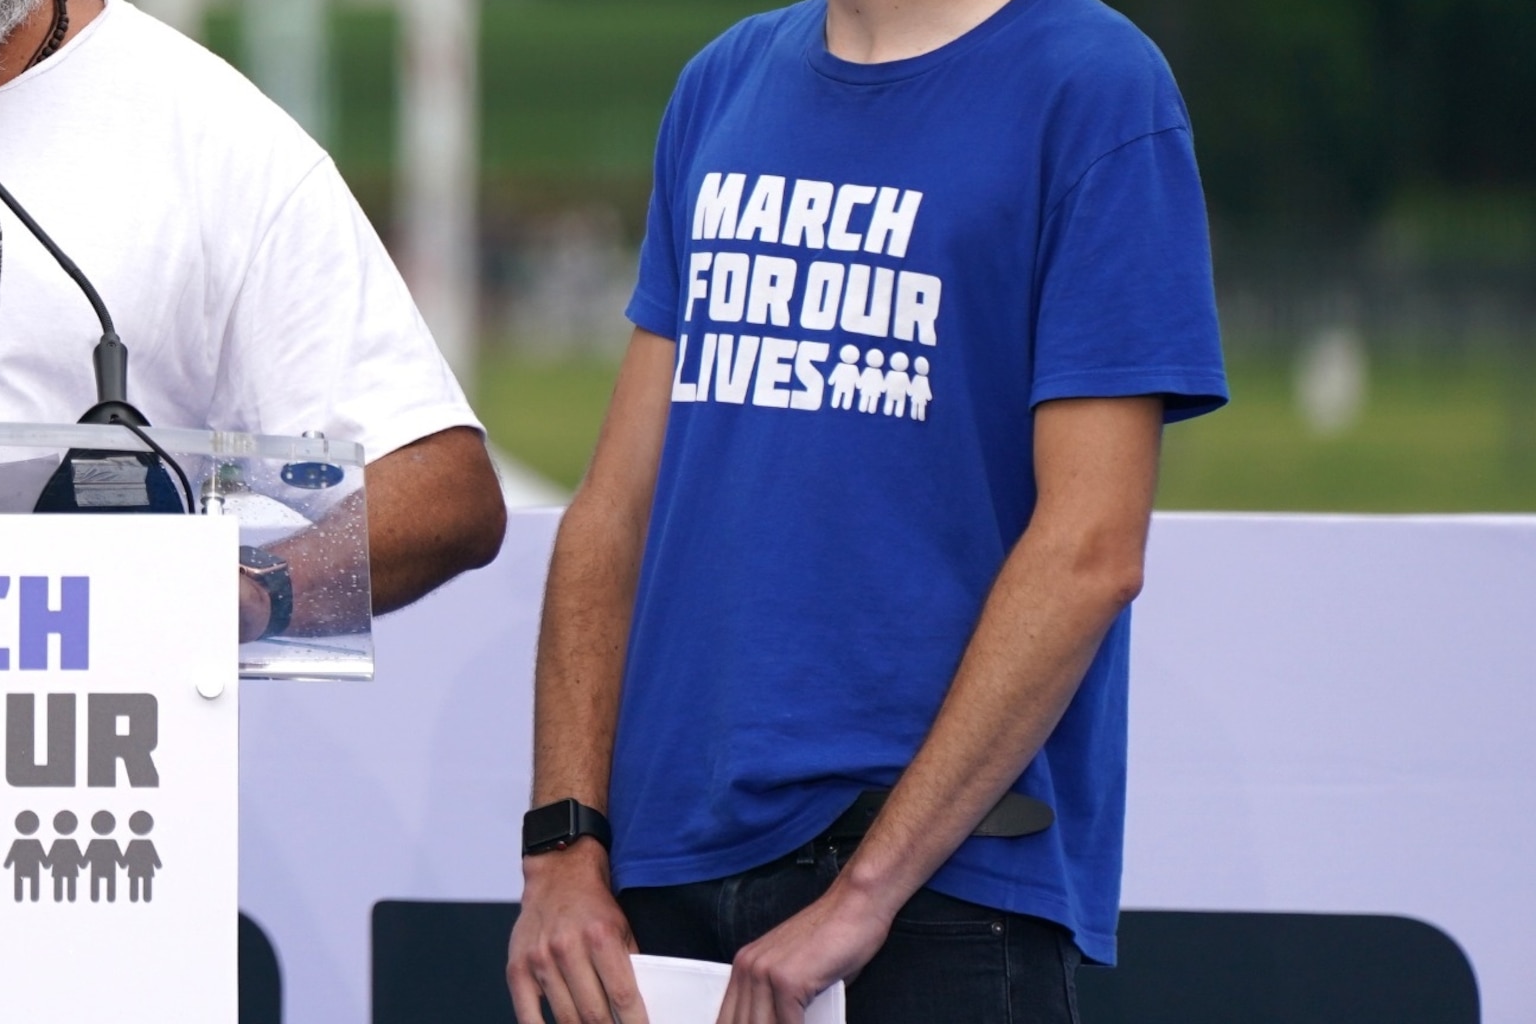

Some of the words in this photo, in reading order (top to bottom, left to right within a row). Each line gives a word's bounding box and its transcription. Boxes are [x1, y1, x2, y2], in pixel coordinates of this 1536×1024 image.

[691, 172, 924, 258] MARCH
[684, 251, 797, 327] FOR
[799, 260, 942, 347] OUR
[671, 333, 830, 411] LIVES
